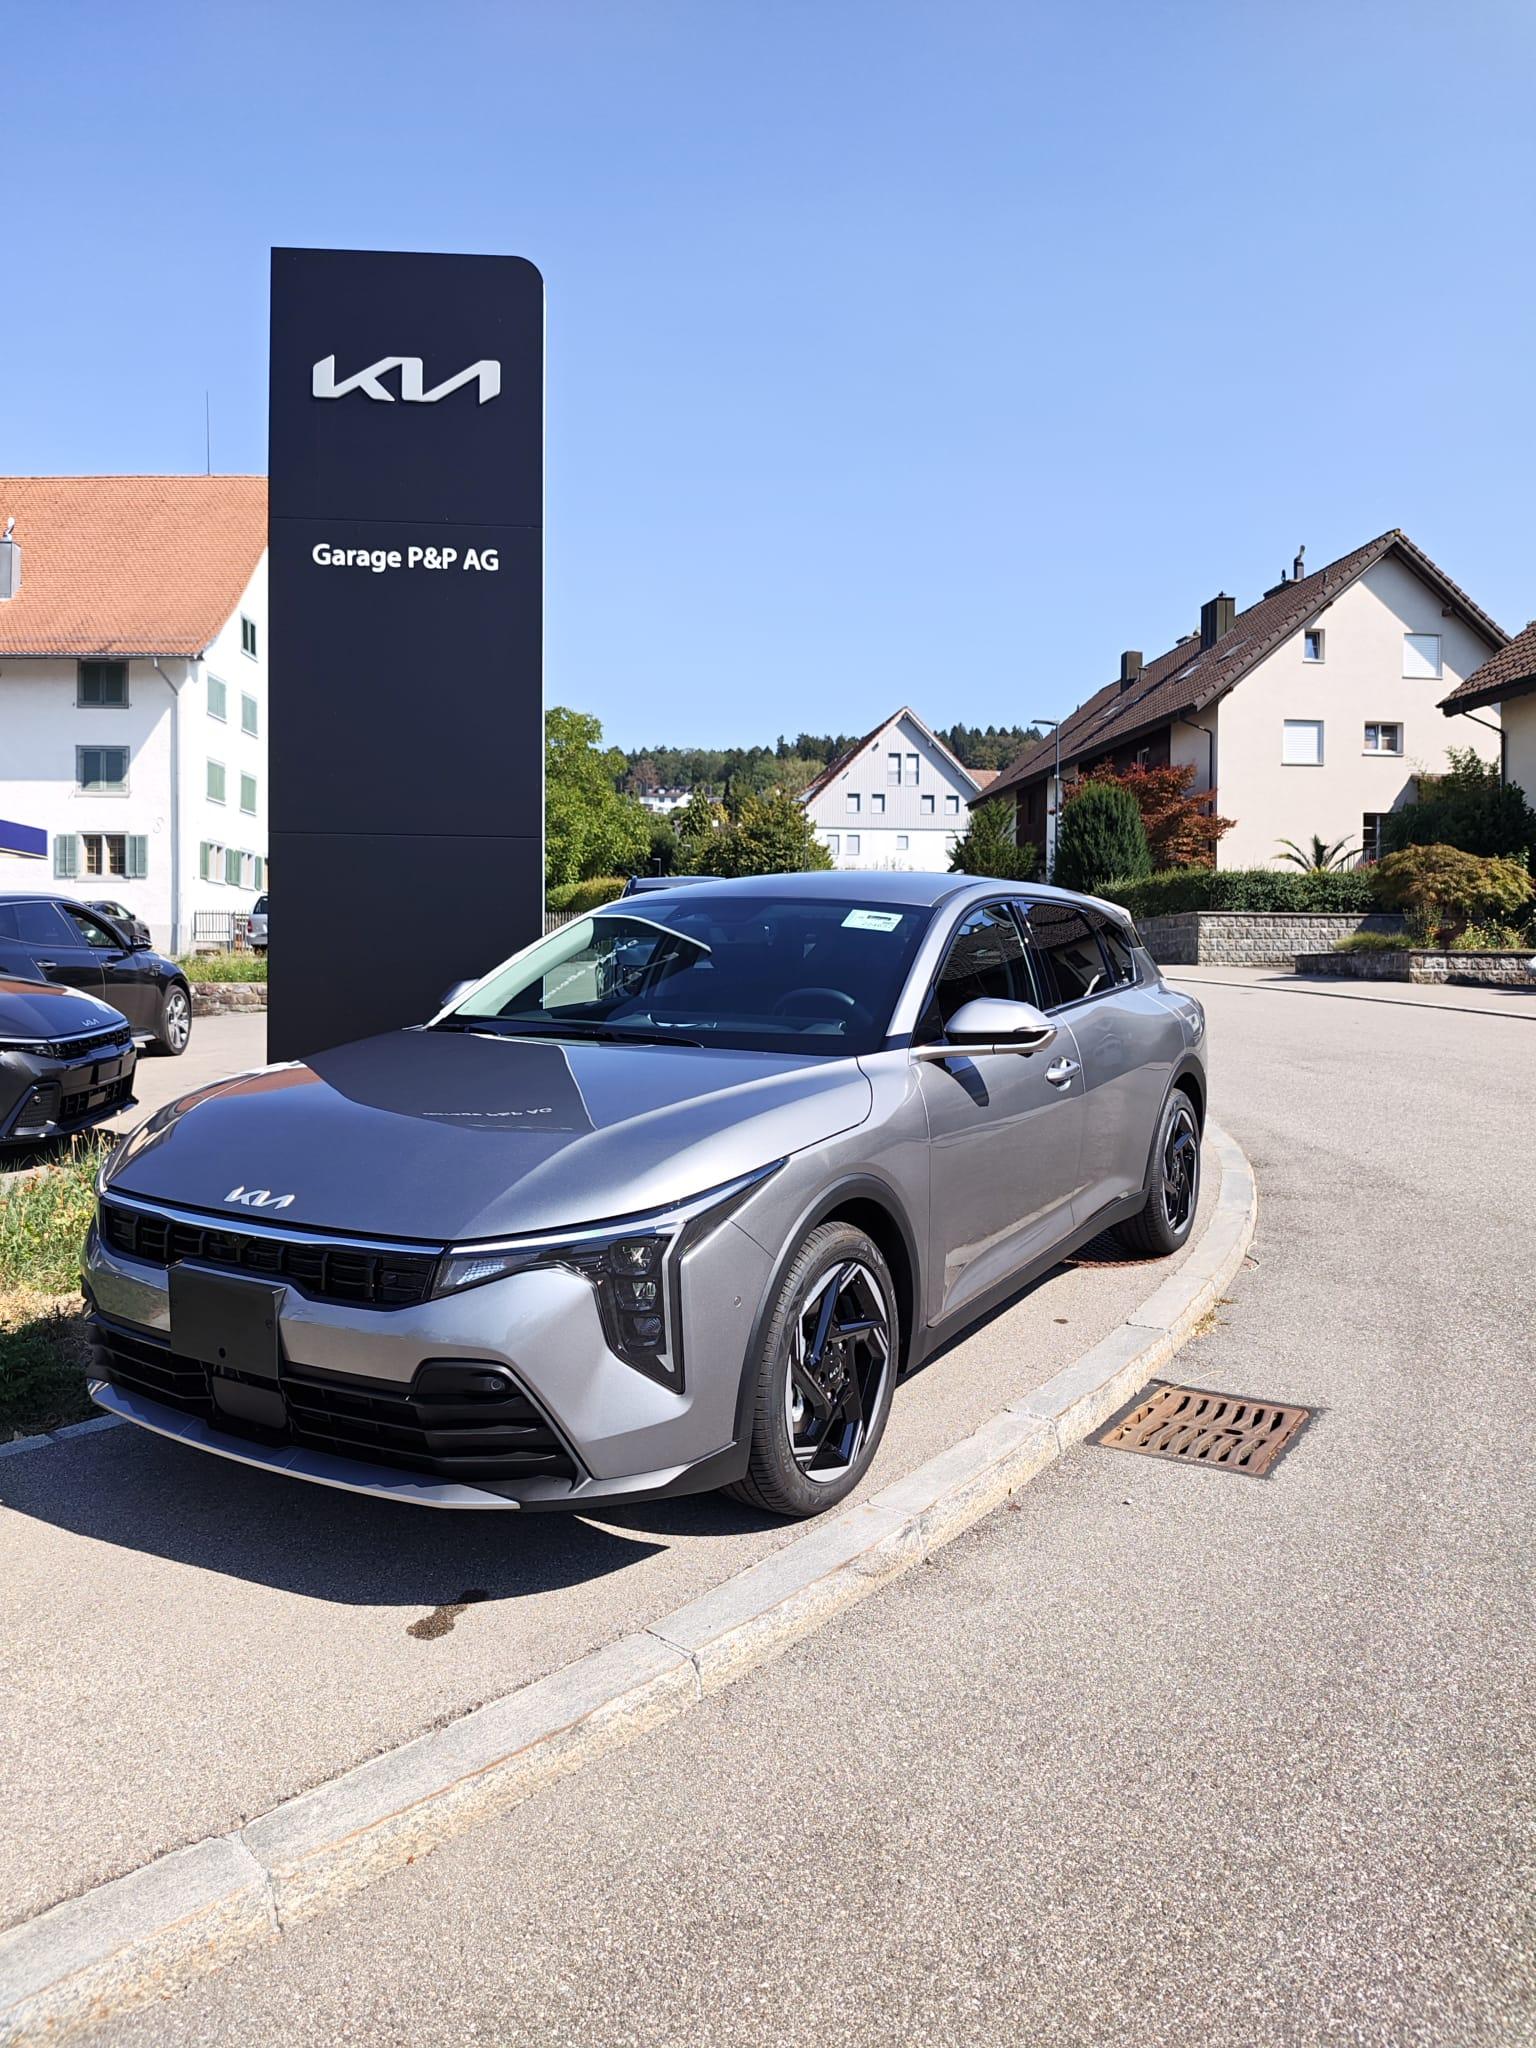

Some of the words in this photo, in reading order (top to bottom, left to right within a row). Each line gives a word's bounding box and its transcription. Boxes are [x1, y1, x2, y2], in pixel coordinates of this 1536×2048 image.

[312, 354, 501, 405] KIA
[312, 543, 402, 573] Garage
[408, 546, 458, 570] P&P
[462, 548, 499, 571] AG
[223, 1185, 296, 1210] KIA
